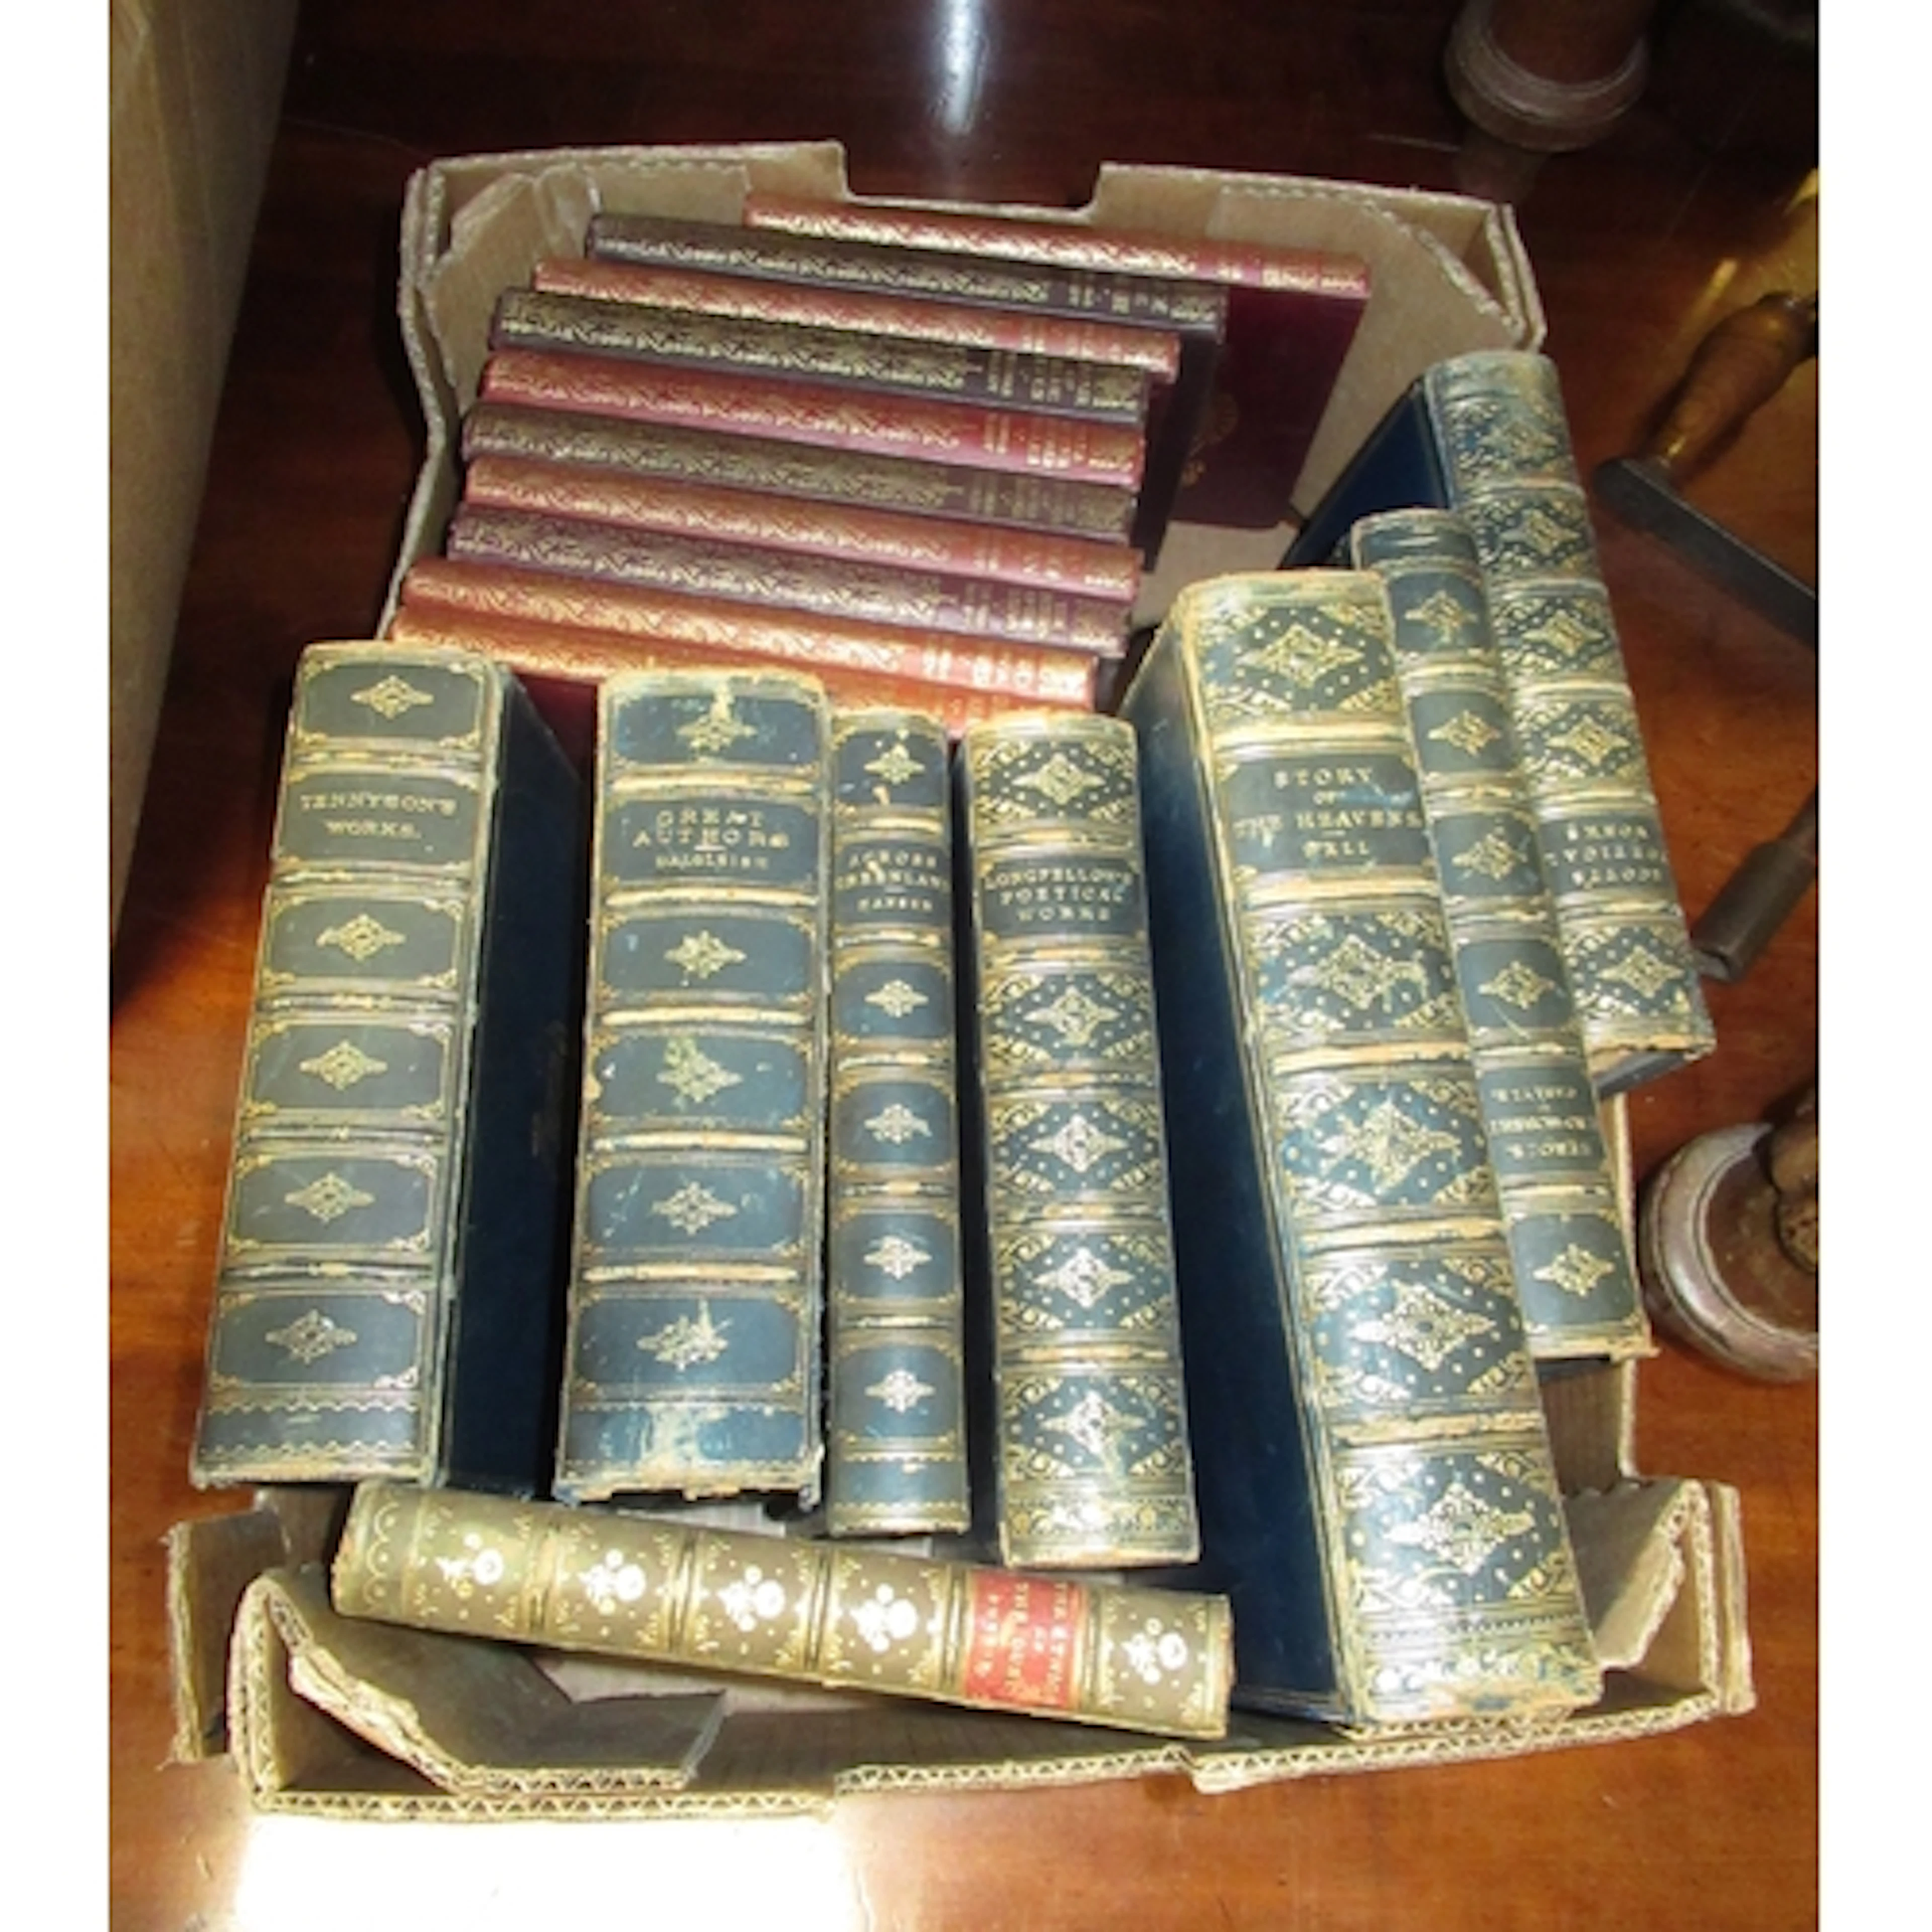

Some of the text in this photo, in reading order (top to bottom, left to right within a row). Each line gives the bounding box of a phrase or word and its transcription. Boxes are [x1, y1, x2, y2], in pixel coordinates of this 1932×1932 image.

[1273, 767, 1374, 789] STORY
[656, 808, 764, 829] GREAT
[632, 828, 790, 848] AUTHORS
[999, 884, 1126, 905] POETICAL
